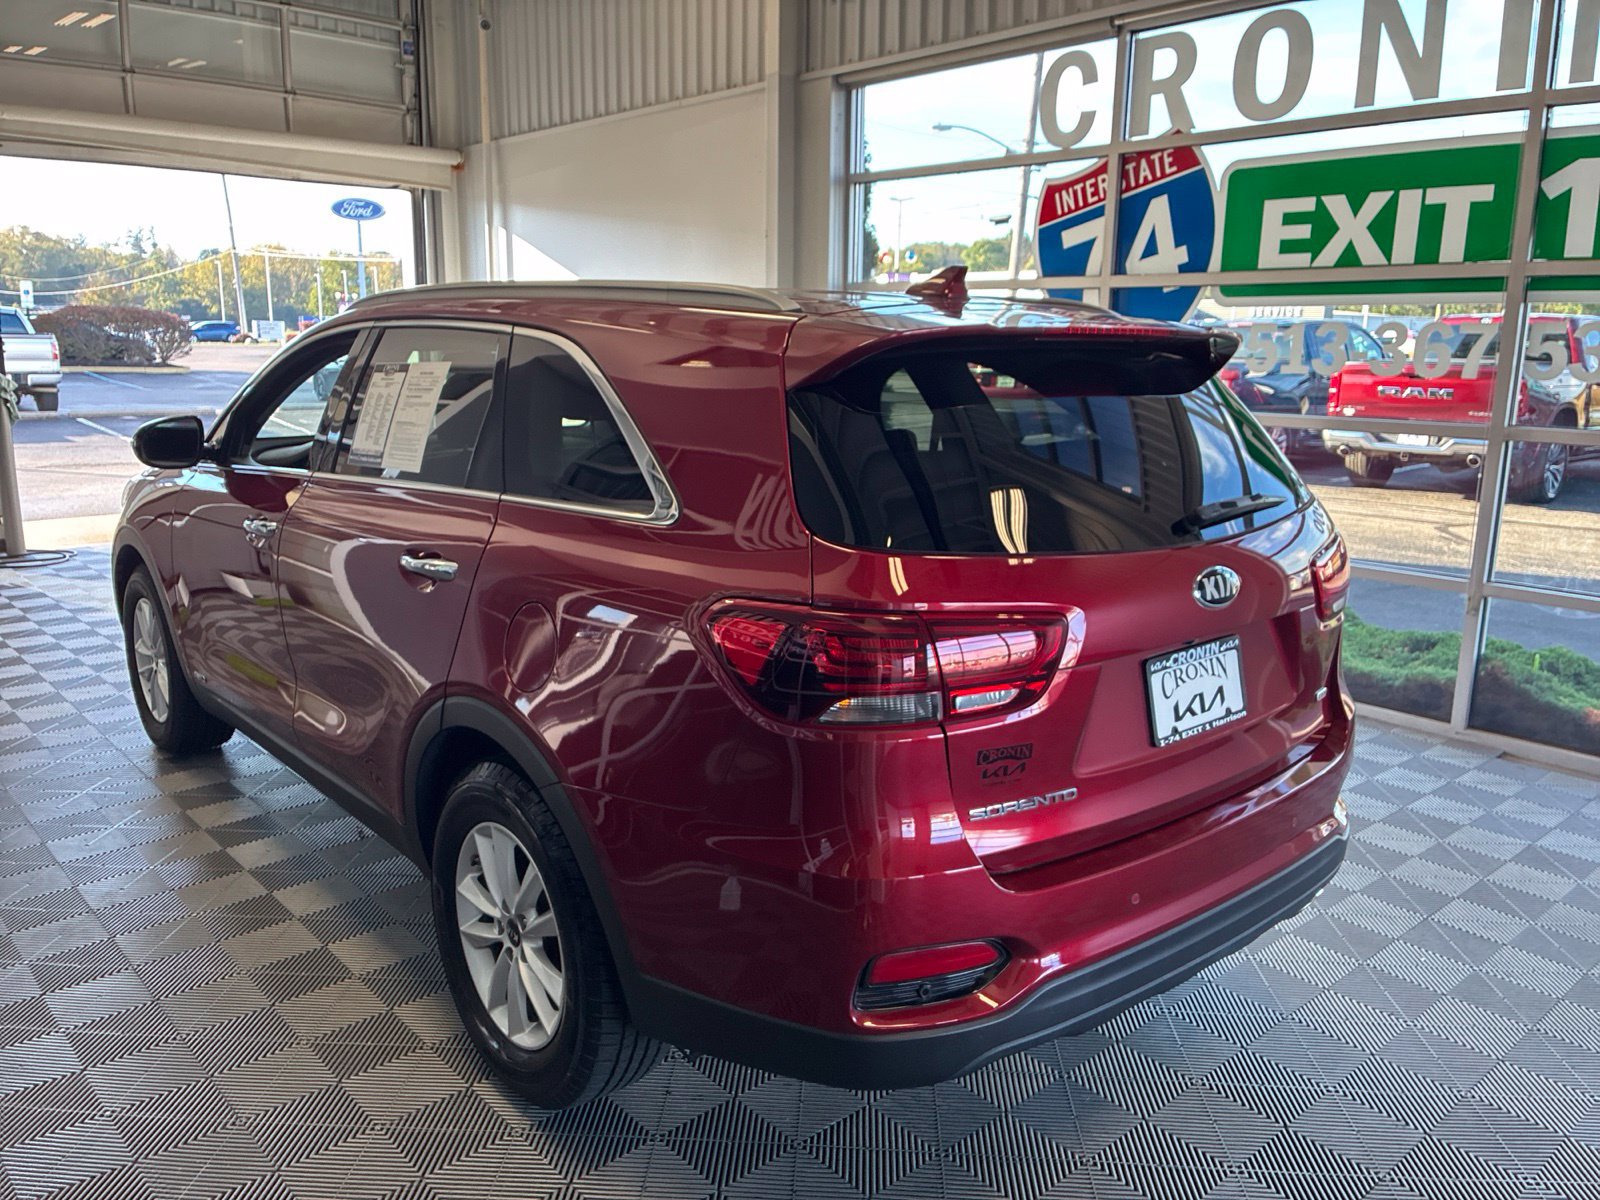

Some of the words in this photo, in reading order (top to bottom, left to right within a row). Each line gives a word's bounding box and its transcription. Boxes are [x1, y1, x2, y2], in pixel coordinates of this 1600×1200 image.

[1055, 149, 1178, 217] INTERTATE
[340, 199, 374, 217] Ford
[1258, 184, 1495, 269] EXIT
[1061, 194, 1189, 307] 74
[1377, 385, 1455, 400] RAM
[1202, 574, 1237, 601] KIA
[1169, 641, 1220, 667] CRONIN
[1161, 654, 1228, 700] CRONIN
[1173, 685, 1225, 722] KIA
[1159, 733, 1181, 747] I-74
[1182, 726, 1204, 739] EXIT
[1212, 711, 1247, 728] Harrison
[977, 743, 1032, 764] CRONIN
[968, 787, 1078, 821] SORENTO
